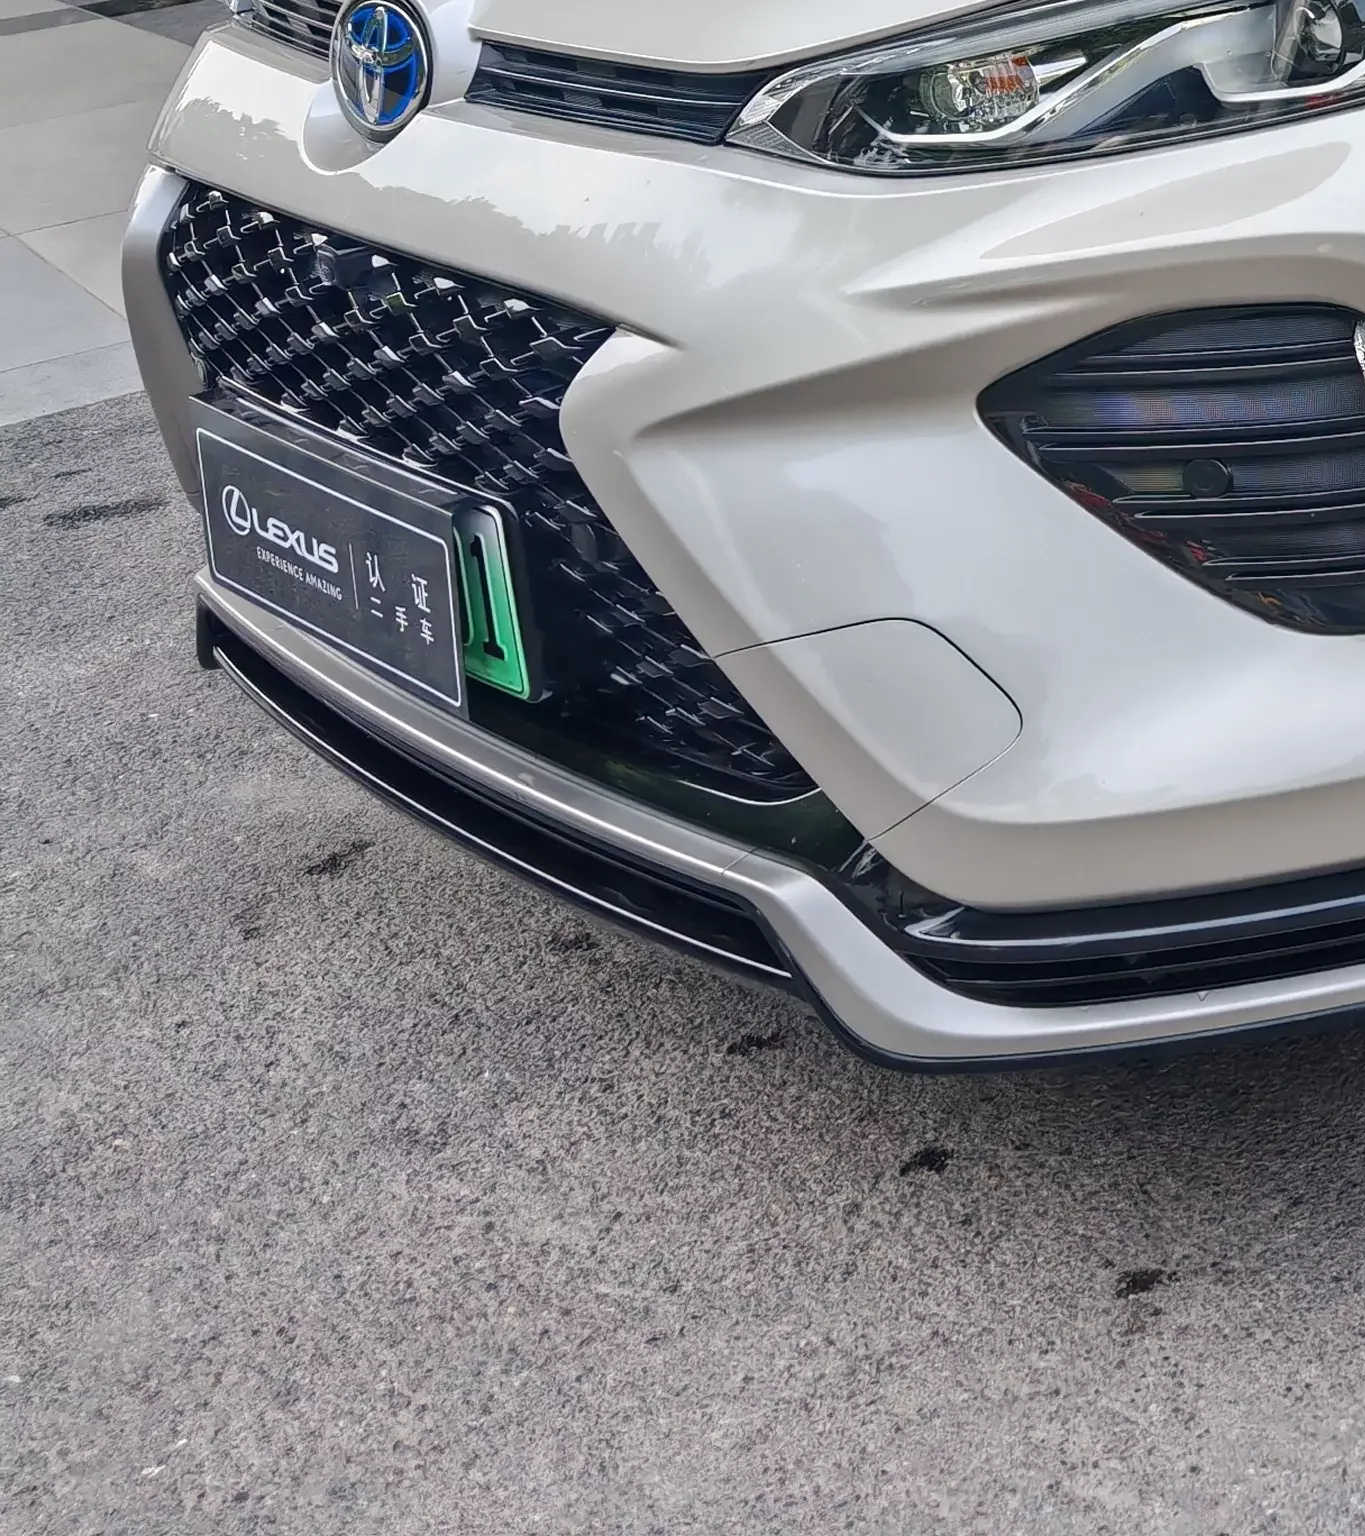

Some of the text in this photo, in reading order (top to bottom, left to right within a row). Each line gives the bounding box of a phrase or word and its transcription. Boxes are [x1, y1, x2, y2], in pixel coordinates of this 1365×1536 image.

[251, 507, 339, 574] LEXUS
[256, 545, 344, 602] EXPERIENCE AMAZING
[366, 551, 431, 614] 认证
[370, 596, 435, 645] 二手车
